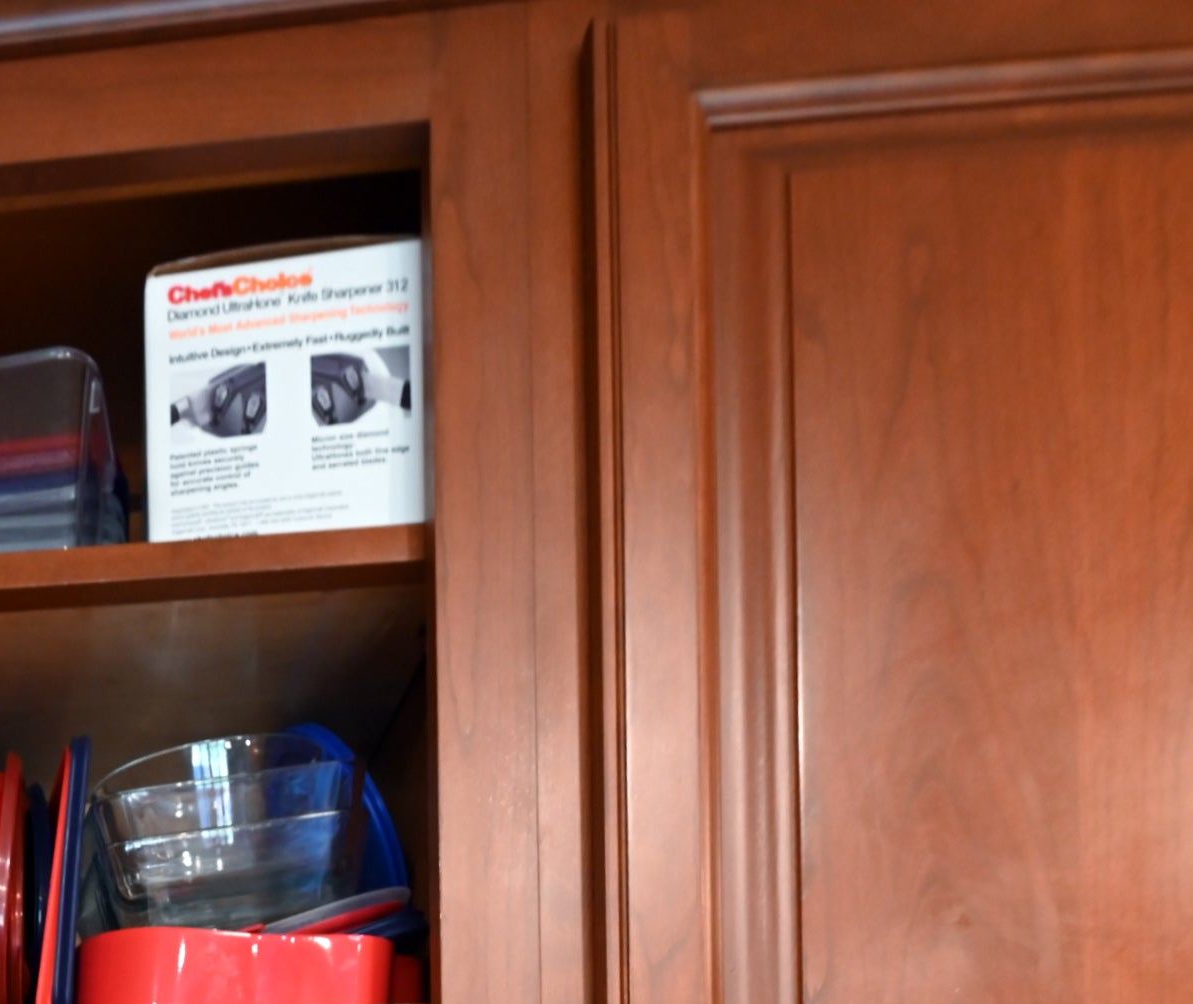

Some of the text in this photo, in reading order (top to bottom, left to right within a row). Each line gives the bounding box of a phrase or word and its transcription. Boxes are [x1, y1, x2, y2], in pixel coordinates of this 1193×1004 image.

[167, 303, 220, 322] Diamond
[288, 290, 318, 305] Knife
[321, 284, 382, 301] Sharpener
[386, 277, 409, 293] 312
[208, 322, 233, 334] Most
[237, 316, 286, 331] Advanced
[289, 308, 348, 324] Sharpening
[169, 352, 208, 364] Intuitive
[211, 346, 246, 358] Design
[253, 336, 302, 352] Extremely
[305, 335, 327, 346] Fast
[335, 328, 383, 342] Ruggedly
